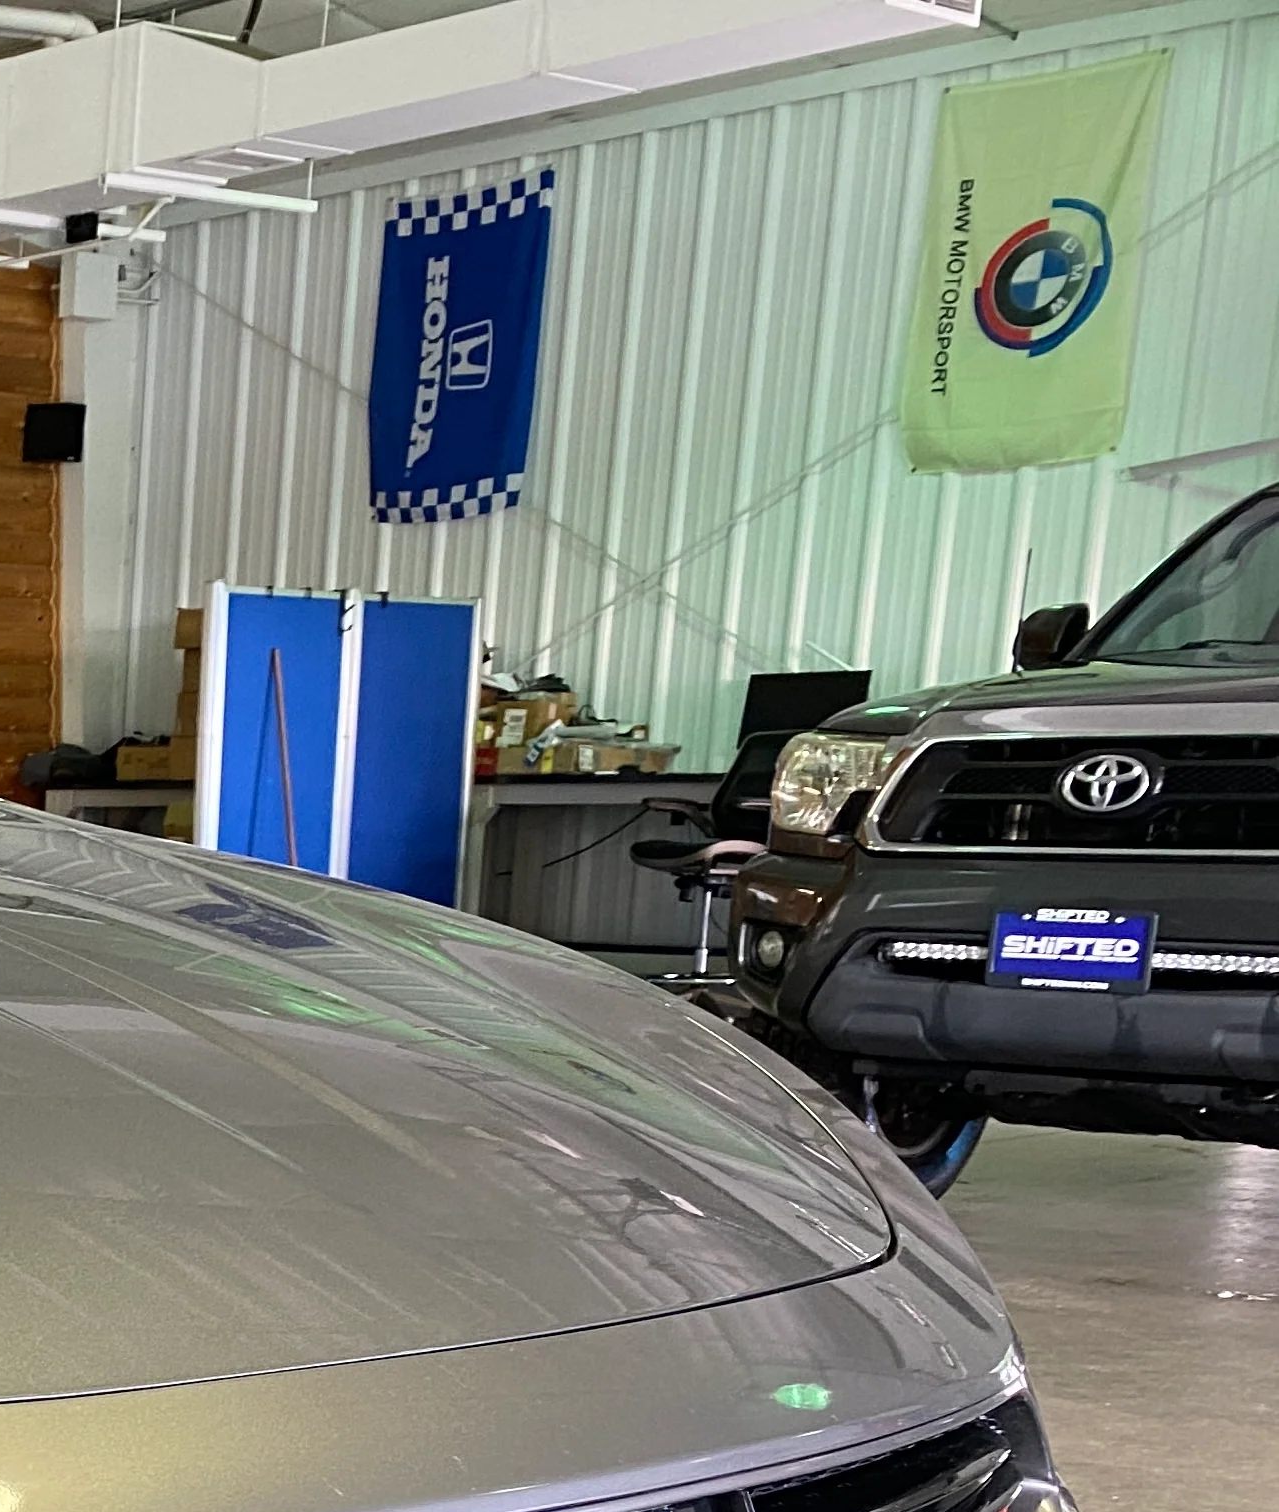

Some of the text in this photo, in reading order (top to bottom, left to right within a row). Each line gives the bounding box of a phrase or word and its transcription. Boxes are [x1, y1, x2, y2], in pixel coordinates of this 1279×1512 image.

[405, 255, 451, 469] HONDA
[930, 178, 975, 397] BMW MOTORSPORT
[1049, 236, 1086, 315] BMW
